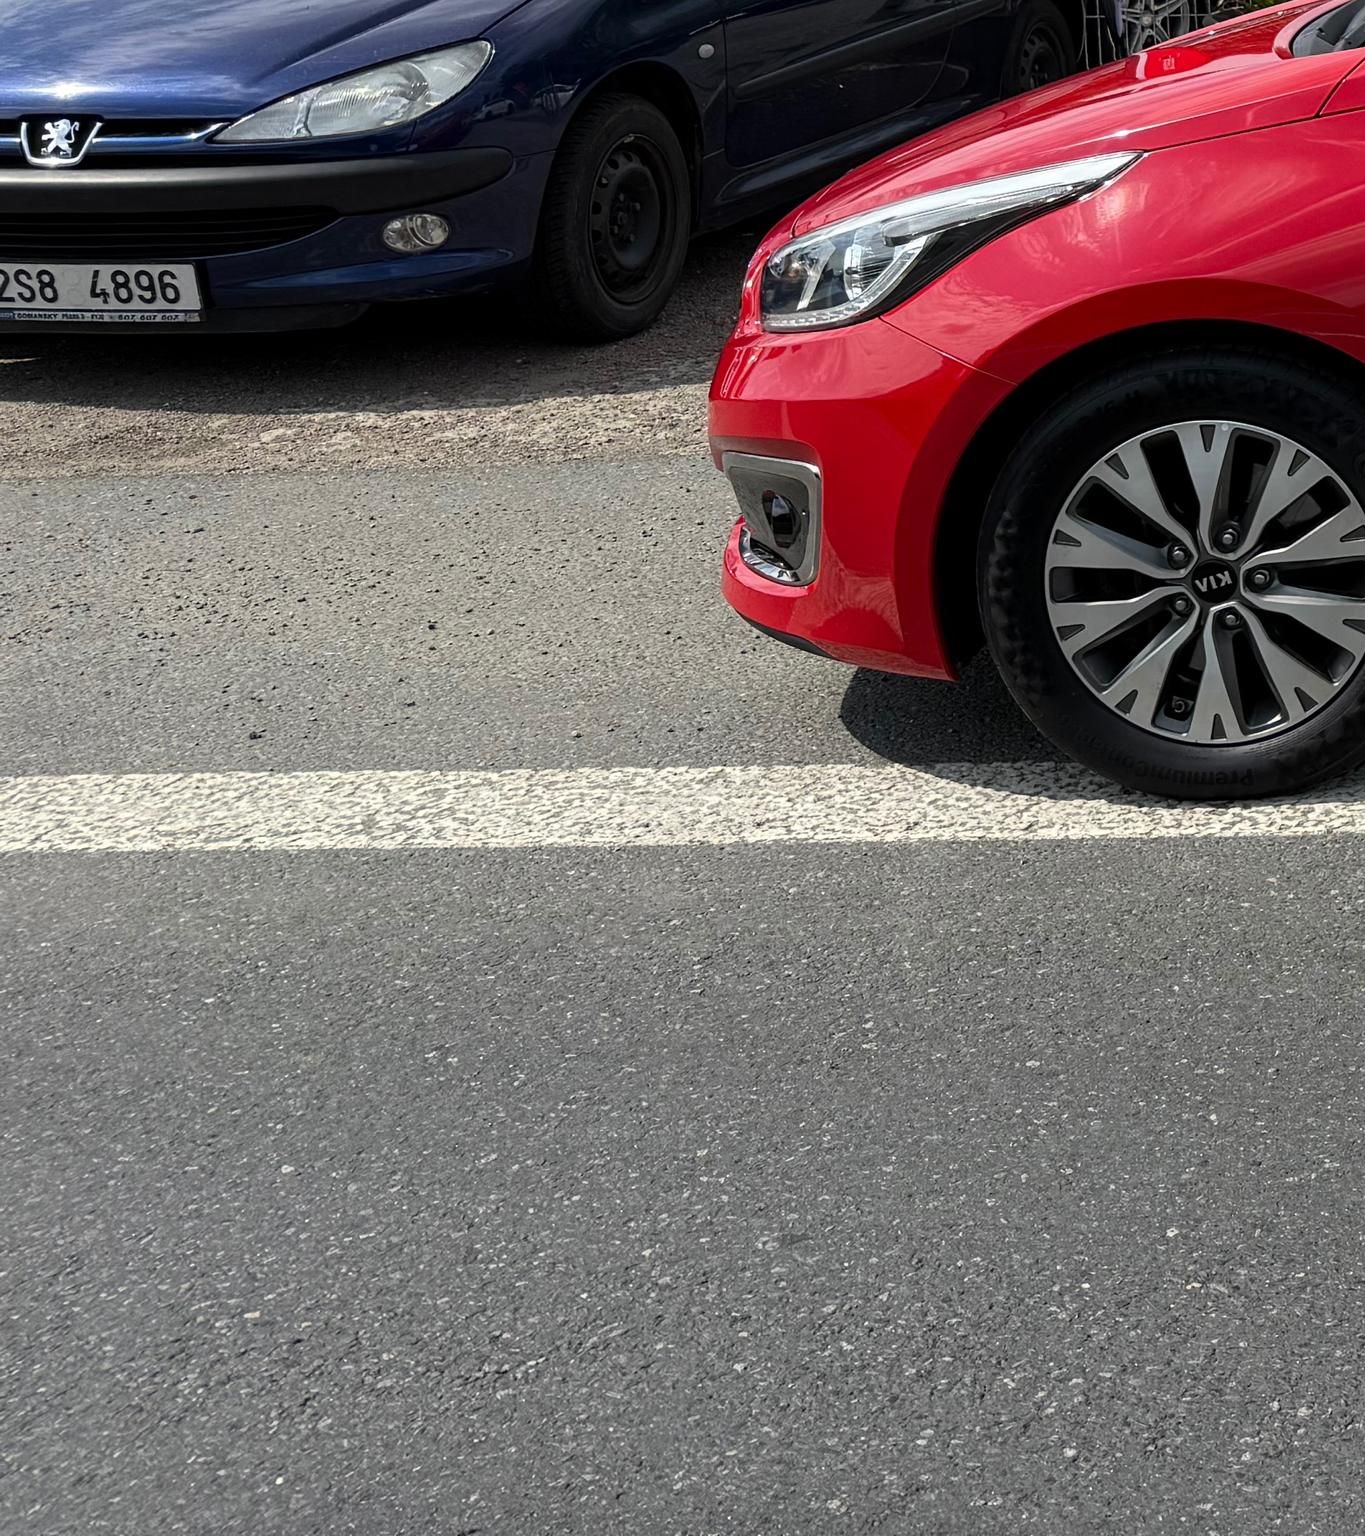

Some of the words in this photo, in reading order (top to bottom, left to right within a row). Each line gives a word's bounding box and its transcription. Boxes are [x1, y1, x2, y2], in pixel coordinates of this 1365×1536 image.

[0, 268, 58, 304] 2S8
[90, 270, 180, 305] 4896
[1194, 570, 1233, 592] KIA
